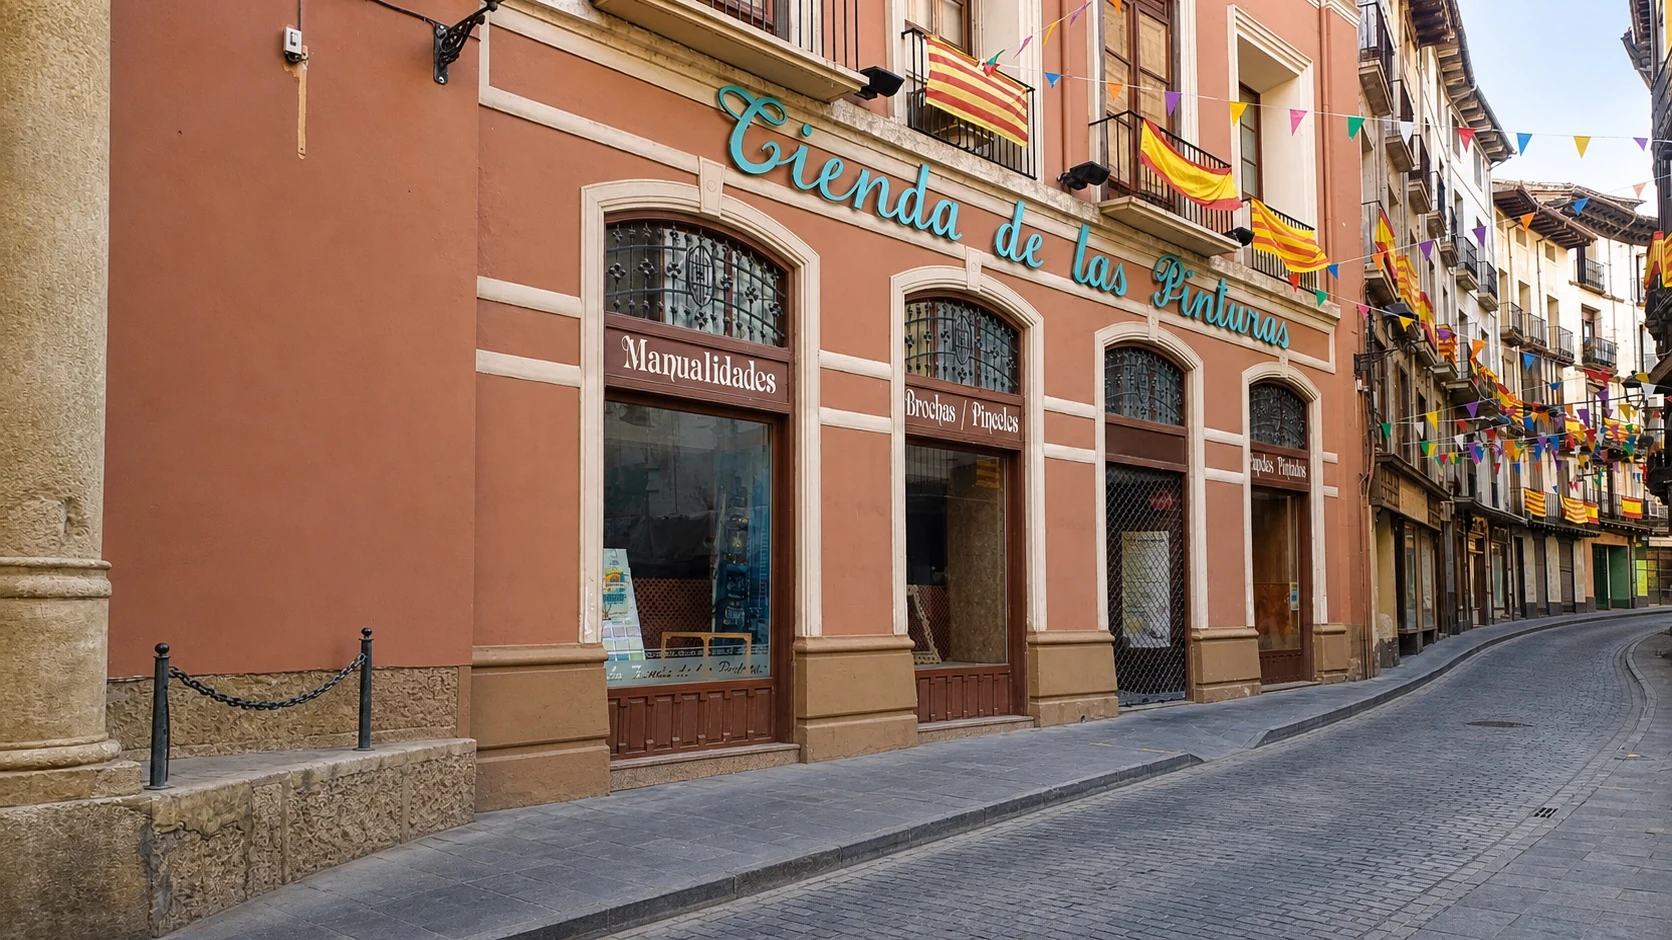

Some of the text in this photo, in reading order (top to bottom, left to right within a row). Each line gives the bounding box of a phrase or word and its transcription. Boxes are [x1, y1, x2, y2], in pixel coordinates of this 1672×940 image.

[718, 85, 1291, 350] Tienda de las Pinturas
[621, 335, 777, 394] Manualidades
[905, 388, 1019, 435] Brochas / Pinceles
